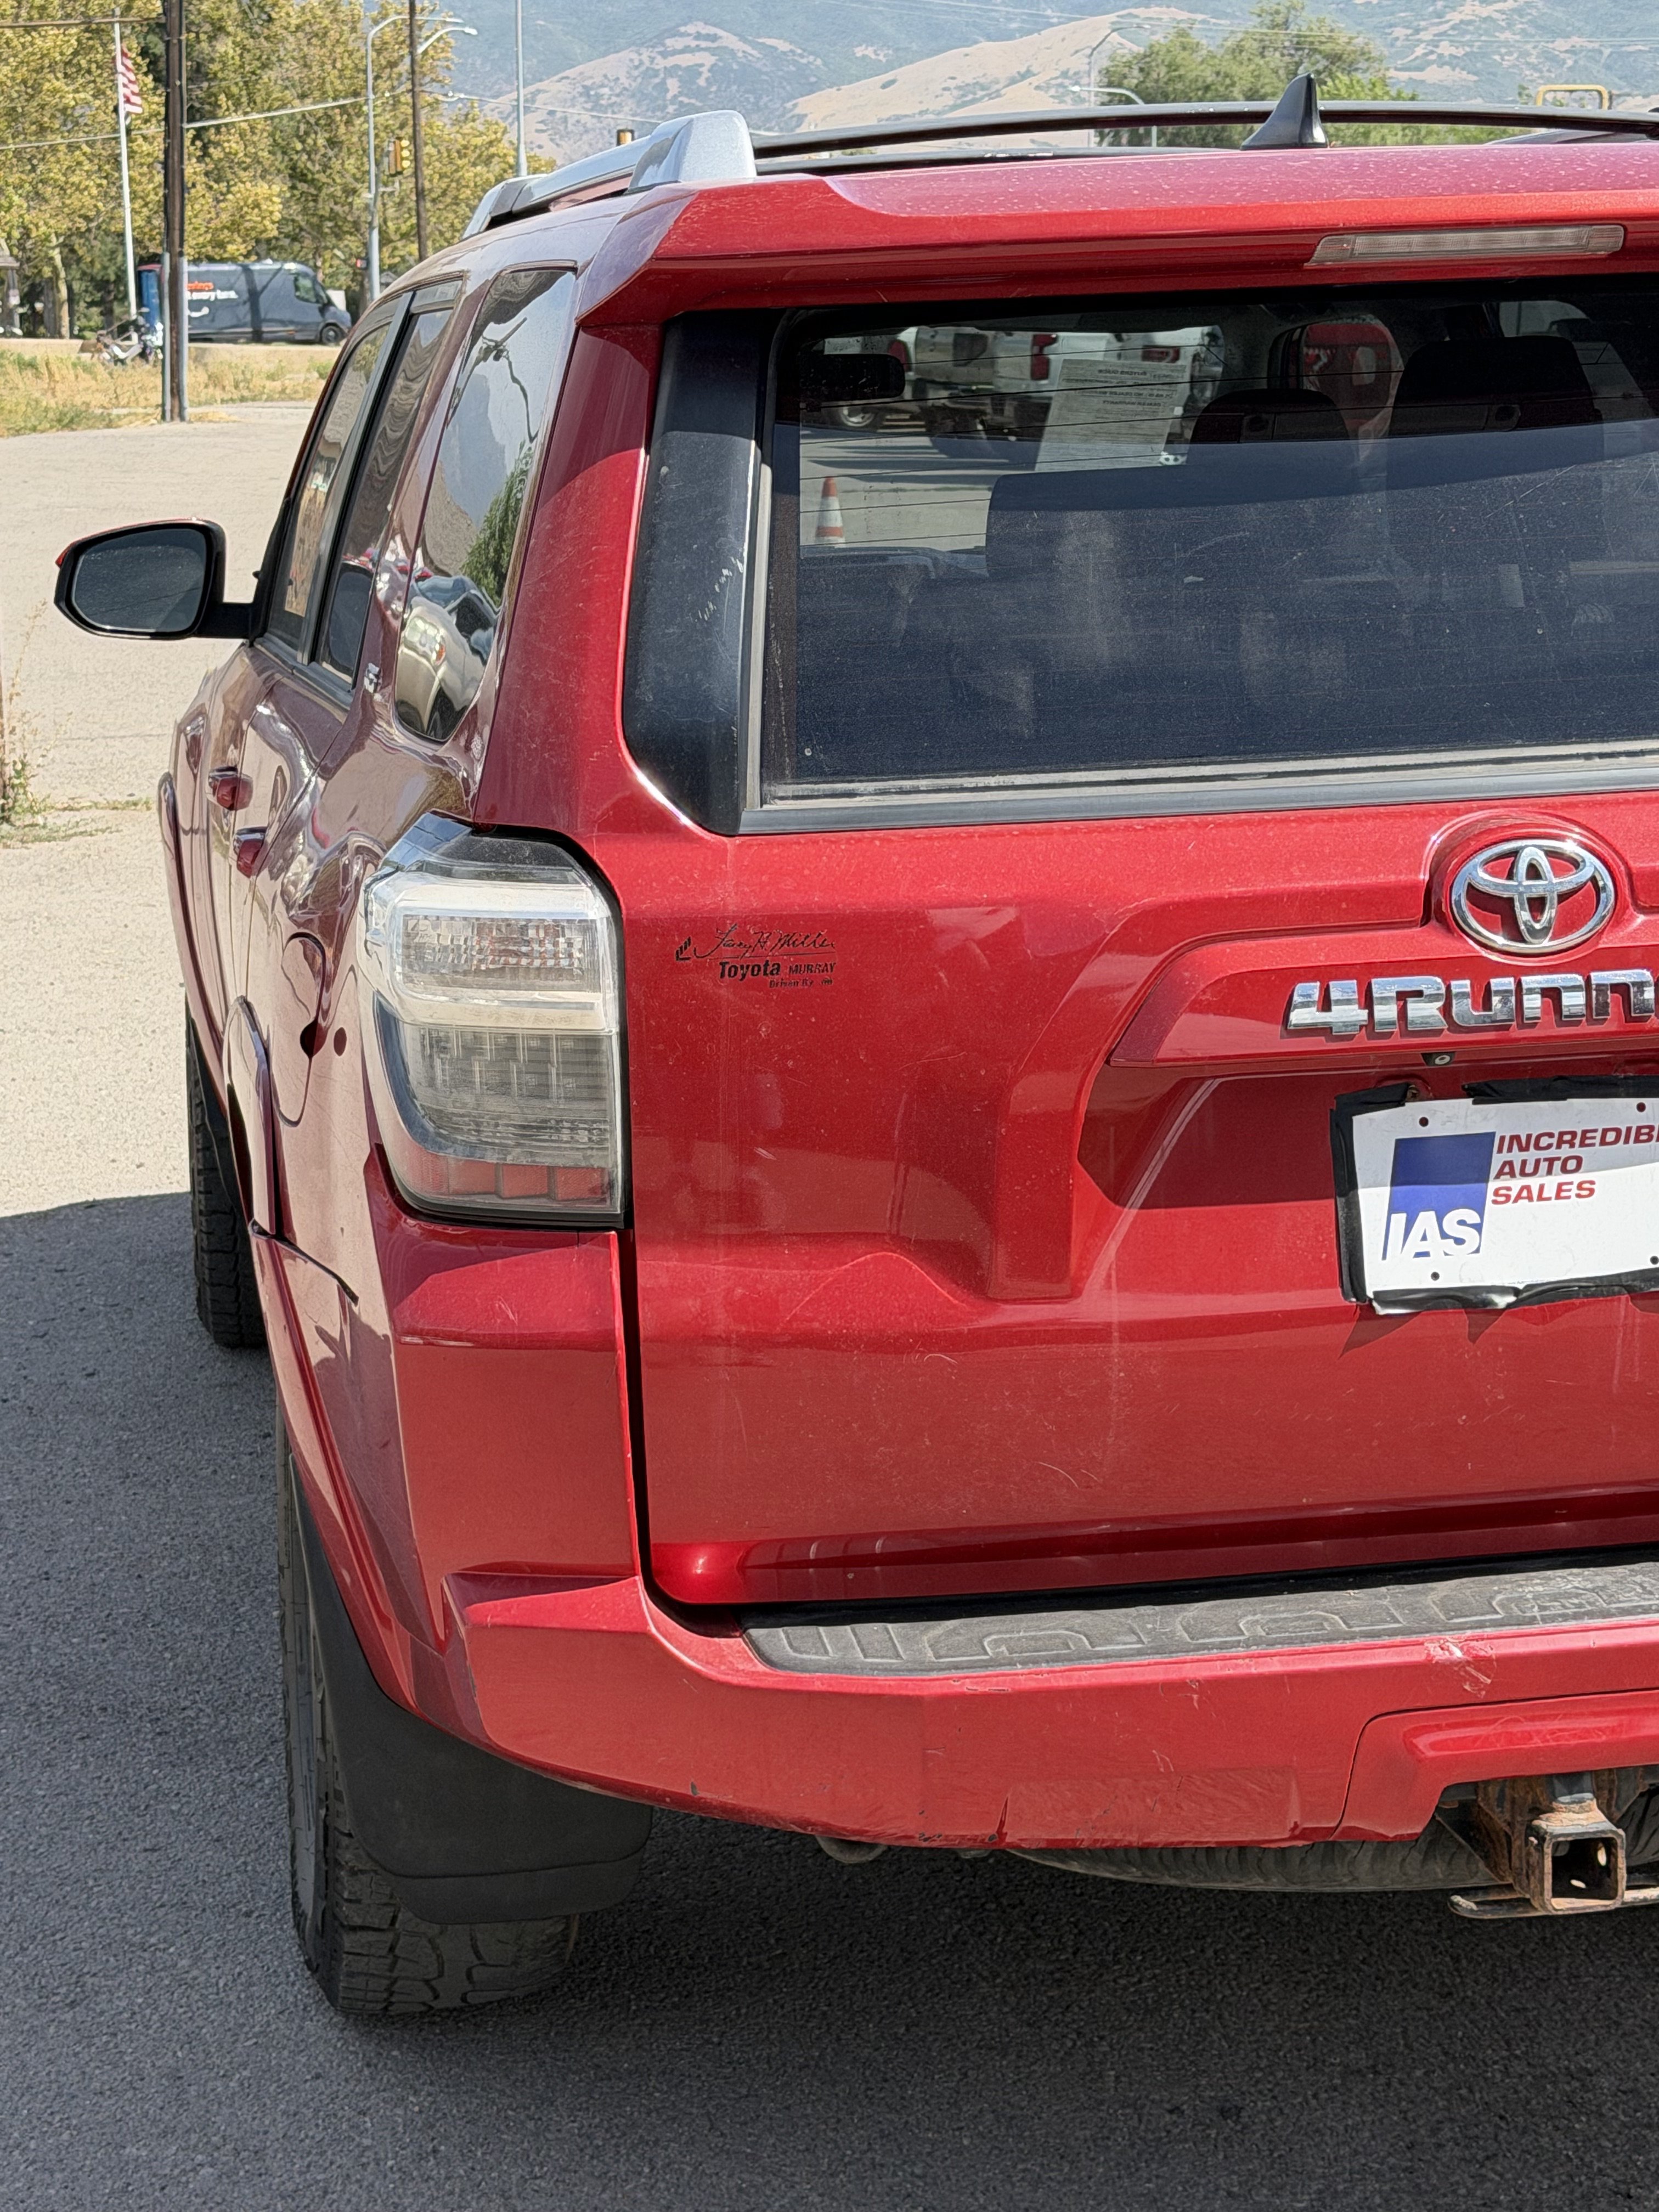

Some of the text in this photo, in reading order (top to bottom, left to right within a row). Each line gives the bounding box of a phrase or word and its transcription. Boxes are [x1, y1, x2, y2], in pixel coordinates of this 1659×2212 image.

[719, 960, 836, 981] Toyota MURRAY
[769, 978, 799, 988] Driven
[1496, 1124, 1659, 1155] INCREDIB
[1493, 1155, 1583, 1180] AUTO
[1491, 1180, 1596, 1205] SALES
[1381, 1208, 1481, 1261] IAS
